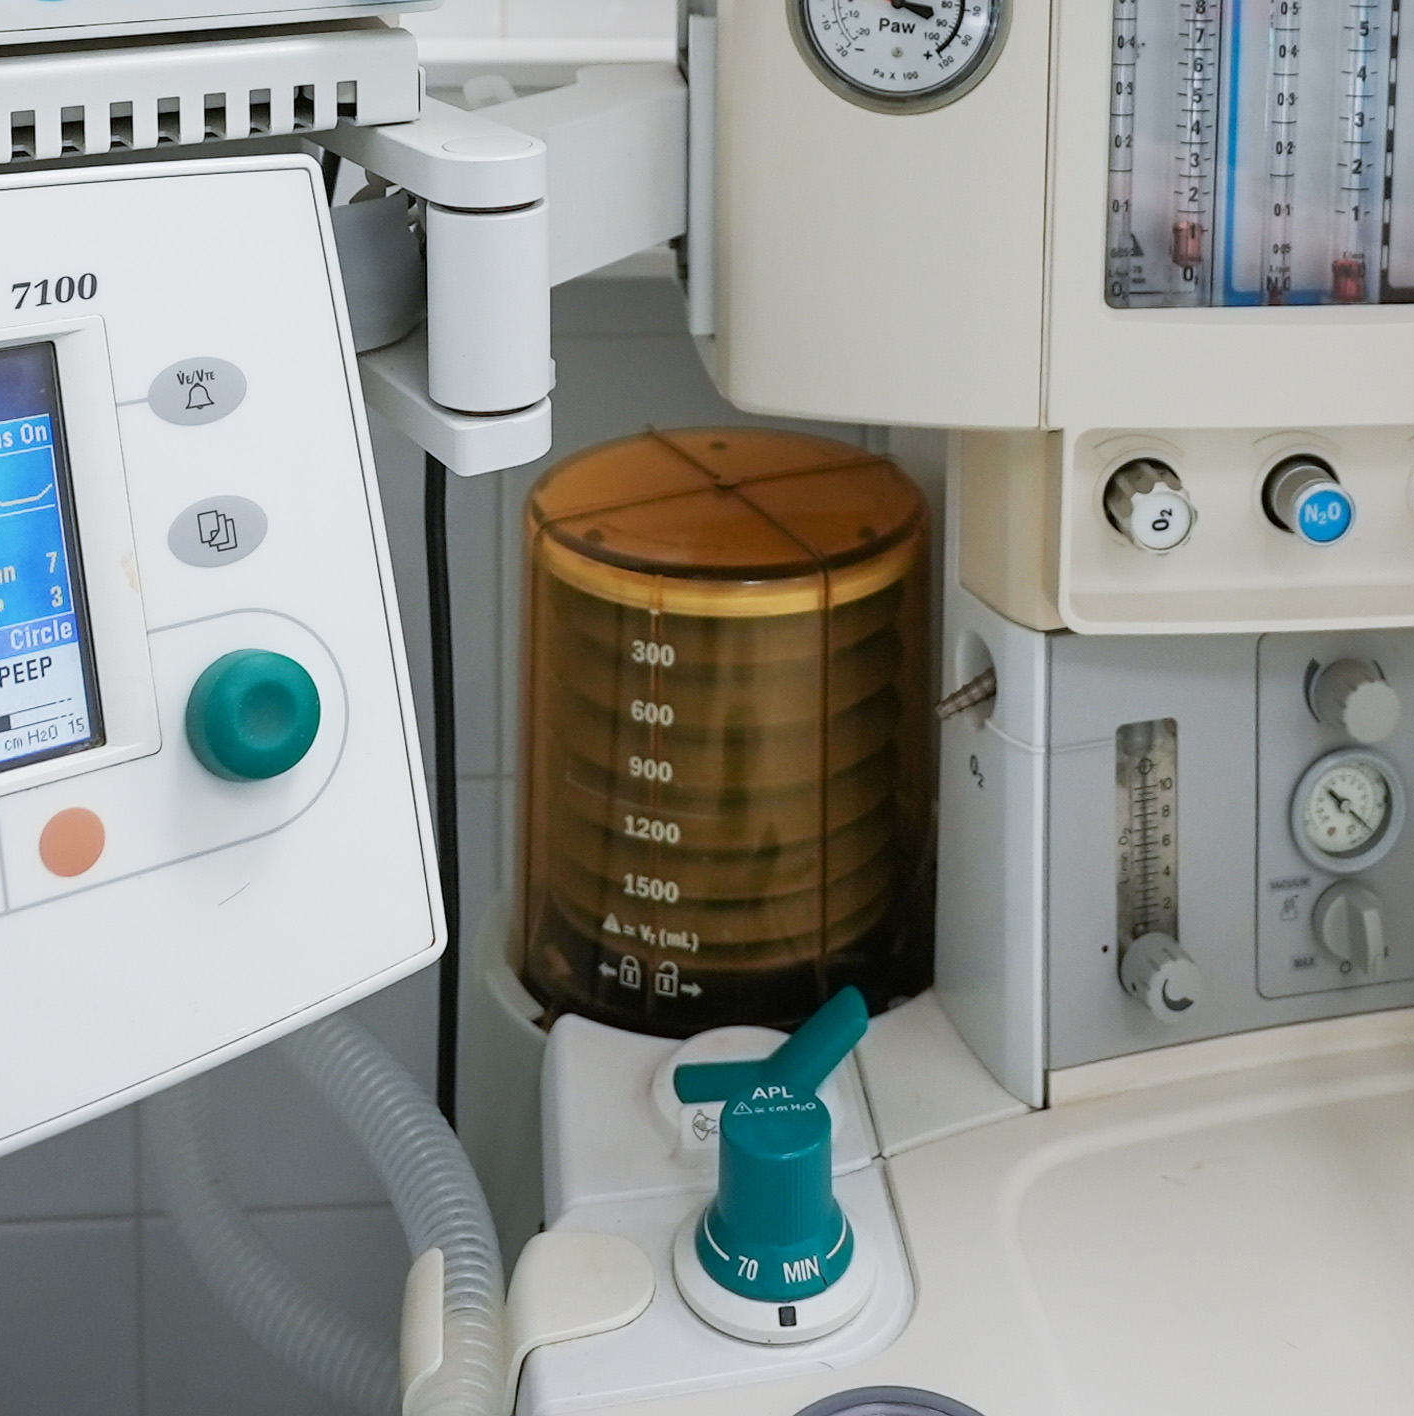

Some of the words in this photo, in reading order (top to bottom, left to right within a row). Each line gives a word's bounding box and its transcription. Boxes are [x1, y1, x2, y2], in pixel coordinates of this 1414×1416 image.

[878, 18, 916, 34] Paw
[10, 271, 99, 311] 7100
[20, 419, 48, 446] On
[9, 617, 74, 650] Circle
[630, 639, 676, 667] 300
[67, 718, 87, 737] 15
[630, 699, 675, 728] 600
[628, 755, 674, 783] 900
[624, 814, 681, 845] 1200
[623, 872, 680, 904] 1500
[751, 1085, 794, 1100] APL
[737, 1255, 759, 1281] 70
[783, 1255, 820, 1284] MIN
